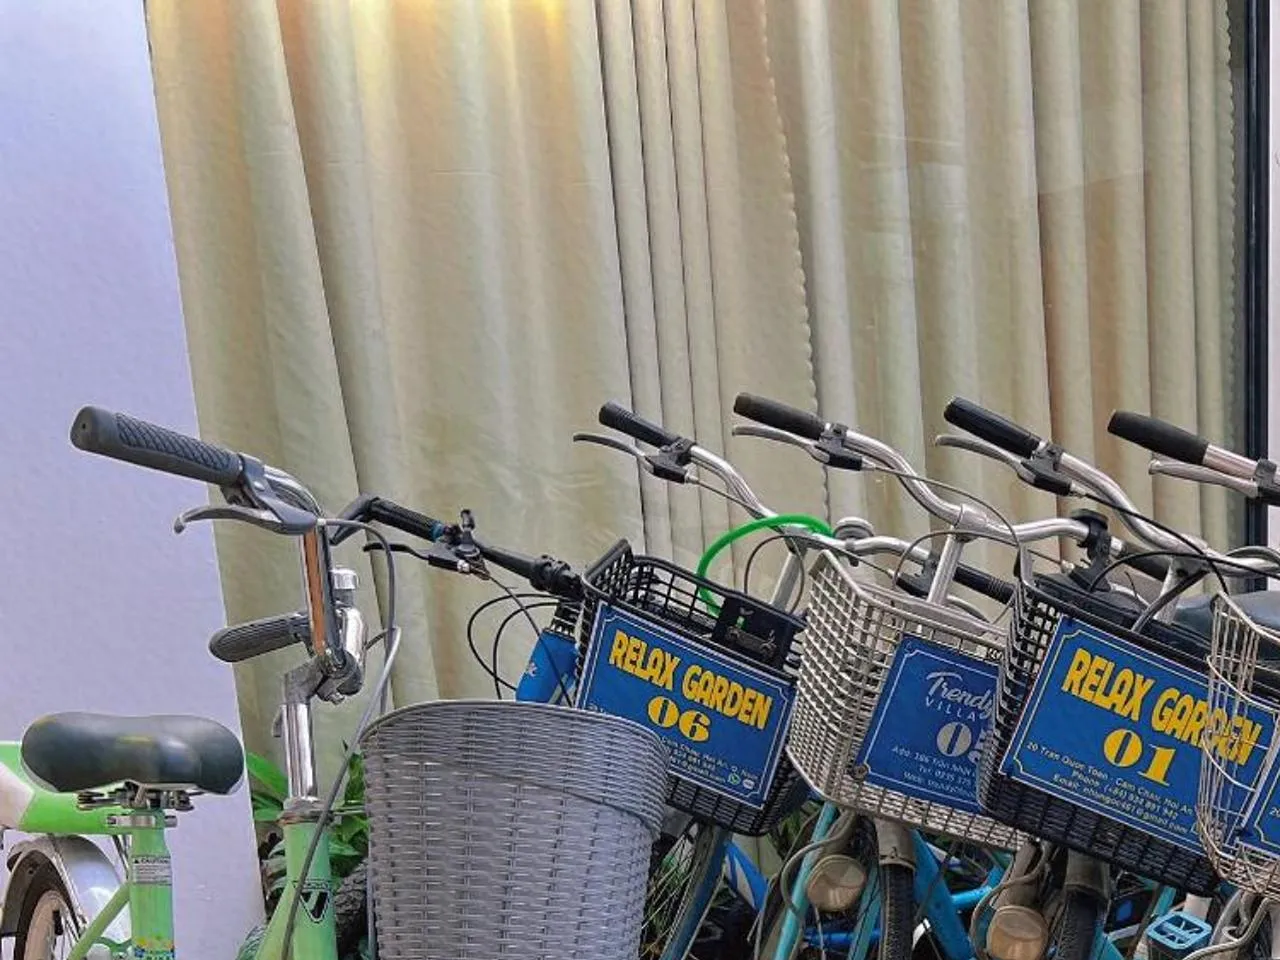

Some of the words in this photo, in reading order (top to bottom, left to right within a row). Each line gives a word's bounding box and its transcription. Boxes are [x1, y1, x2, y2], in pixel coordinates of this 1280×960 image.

[609, 629, 680, 690] RELAX
[682, 665, 772, 729] GARDEN
[1061, 648, 1155, 722] RELAX
[1151, 688, 1262, 765] GARDEN
[648, 696, 711, 741] 06
[937, 722, 984, 764] 0
[1103, 728, 1176, 787] 01
